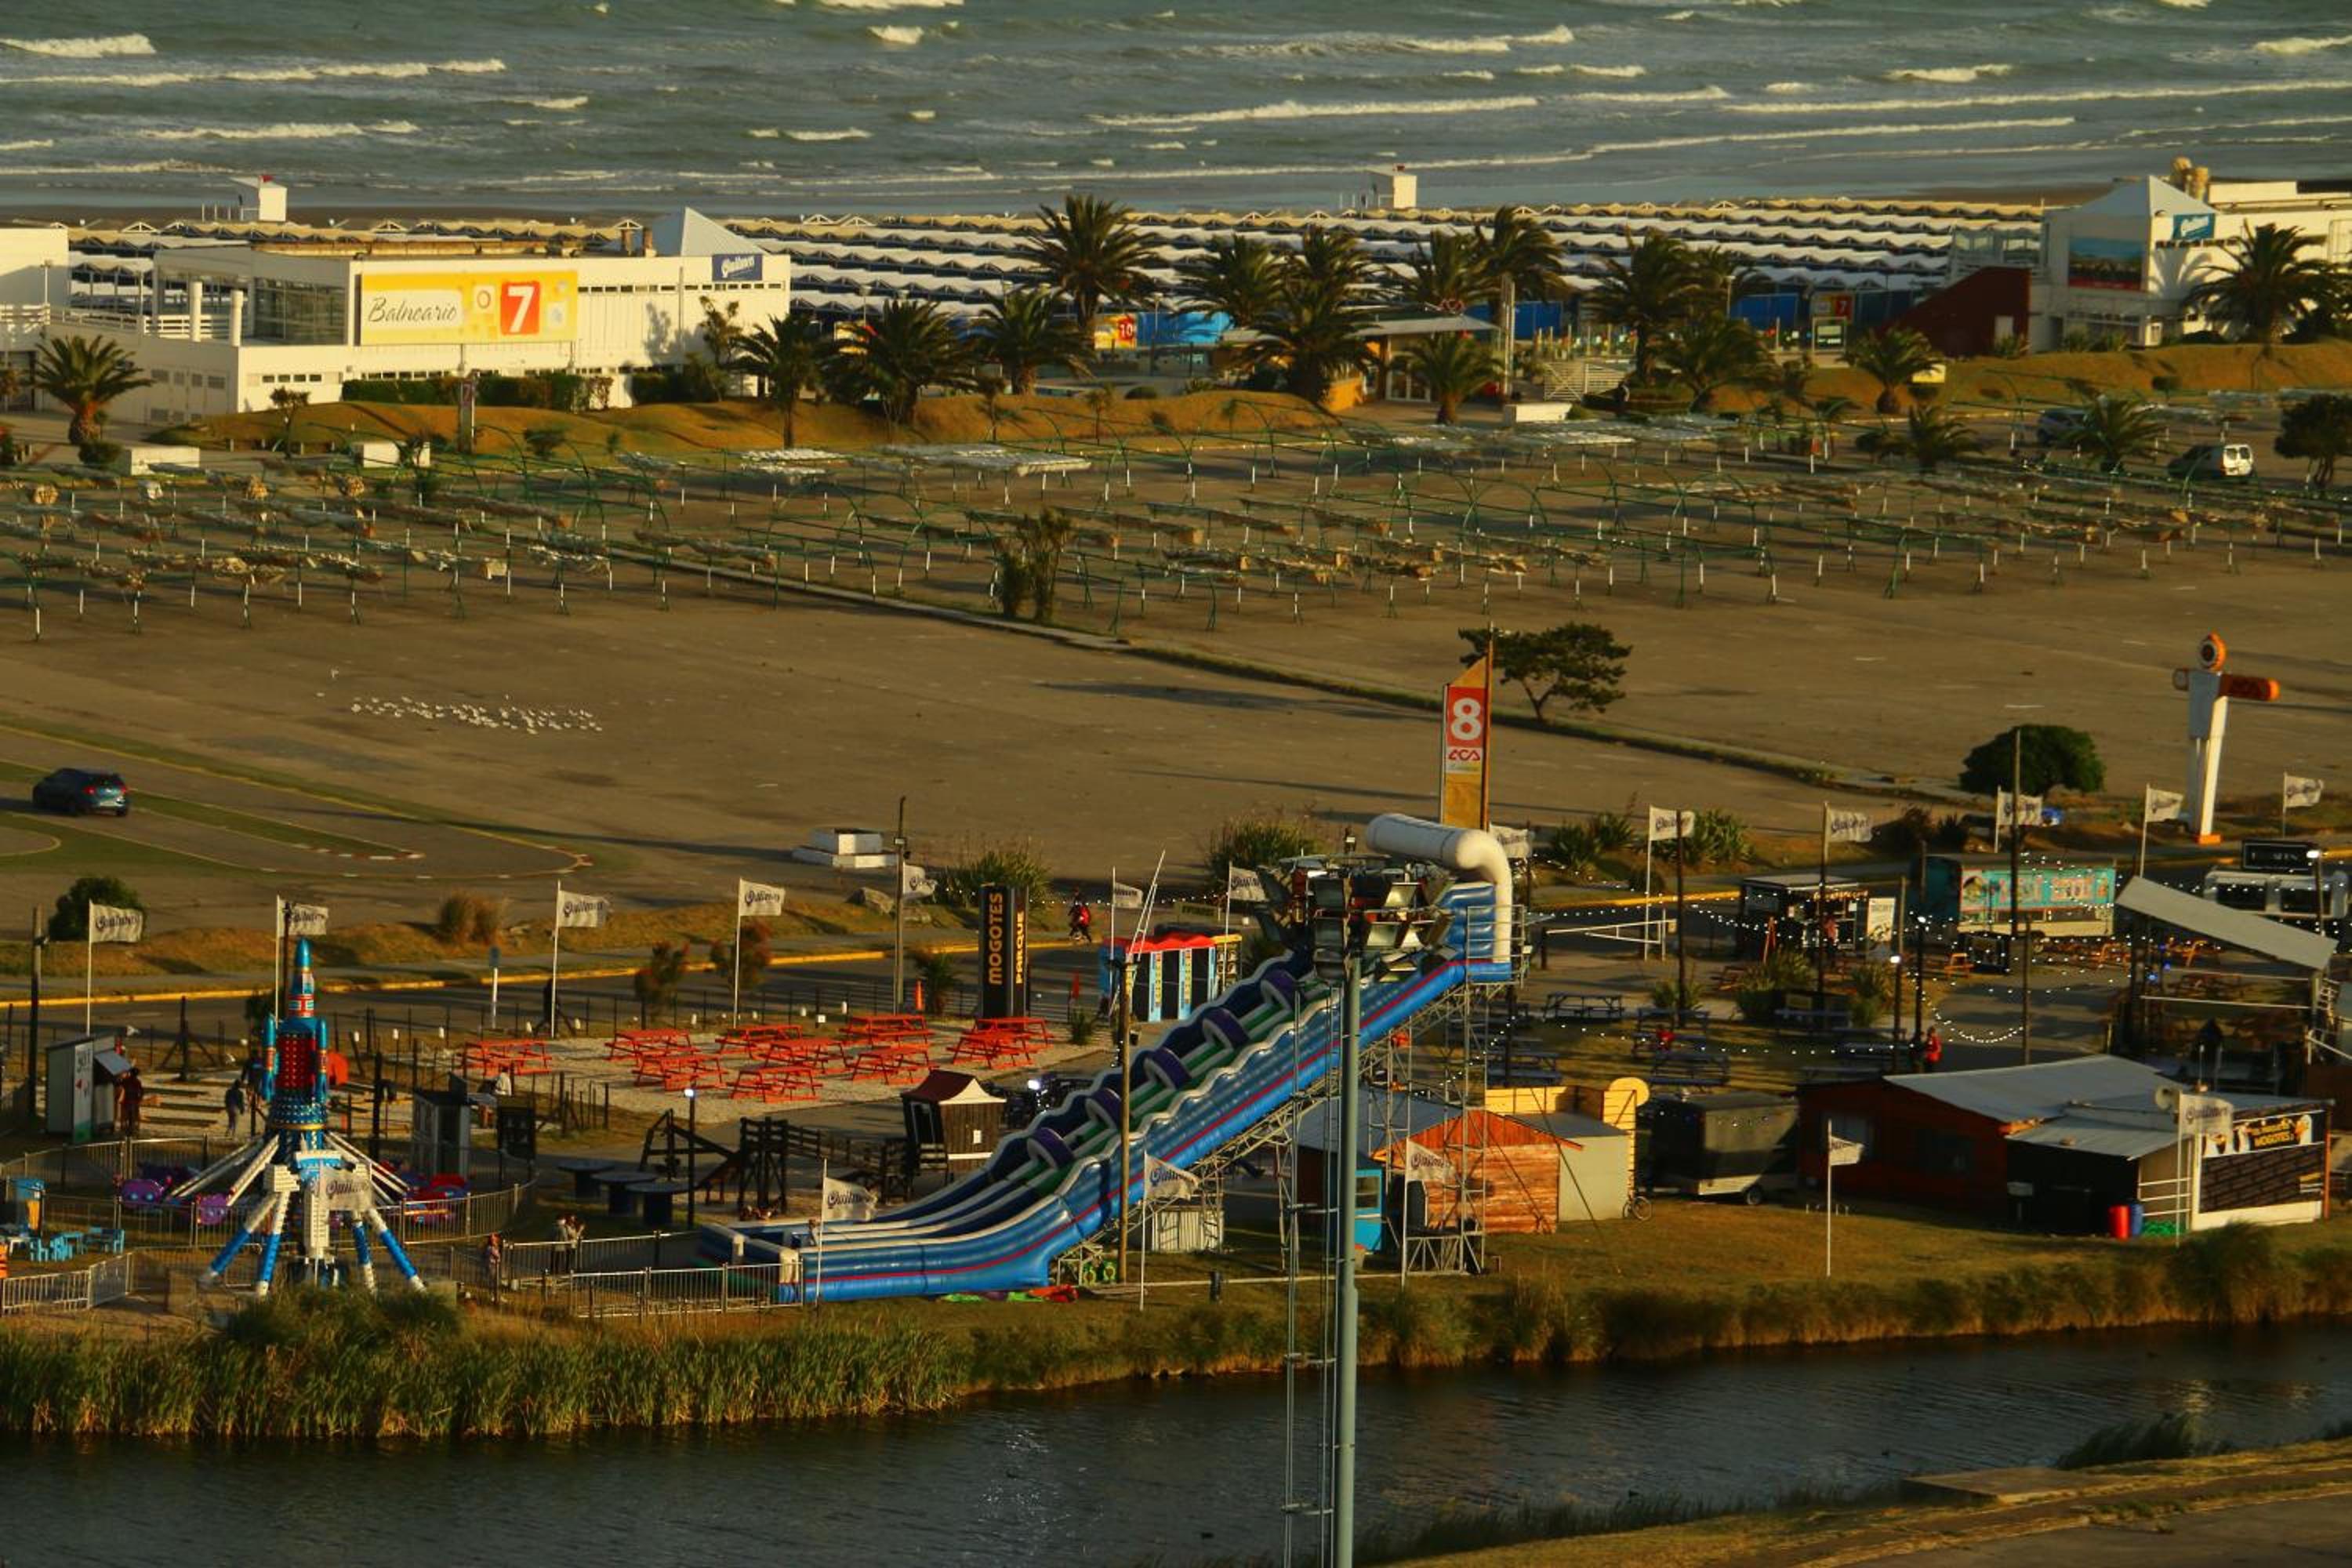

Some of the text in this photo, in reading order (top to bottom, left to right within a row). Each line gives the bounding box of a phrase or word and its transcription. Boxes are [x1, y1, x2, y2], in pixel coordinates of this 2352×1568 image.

[368, 296, 458, 323] Balneario
[507, 285, 535, 333] 7
[1450, 698, 1481, 741] 8
[1449, 750, 1480, 761] ACA
[989, 892, 1004, 985] MOGOTES
[1015, 910, 1025, 985] PARQUE
